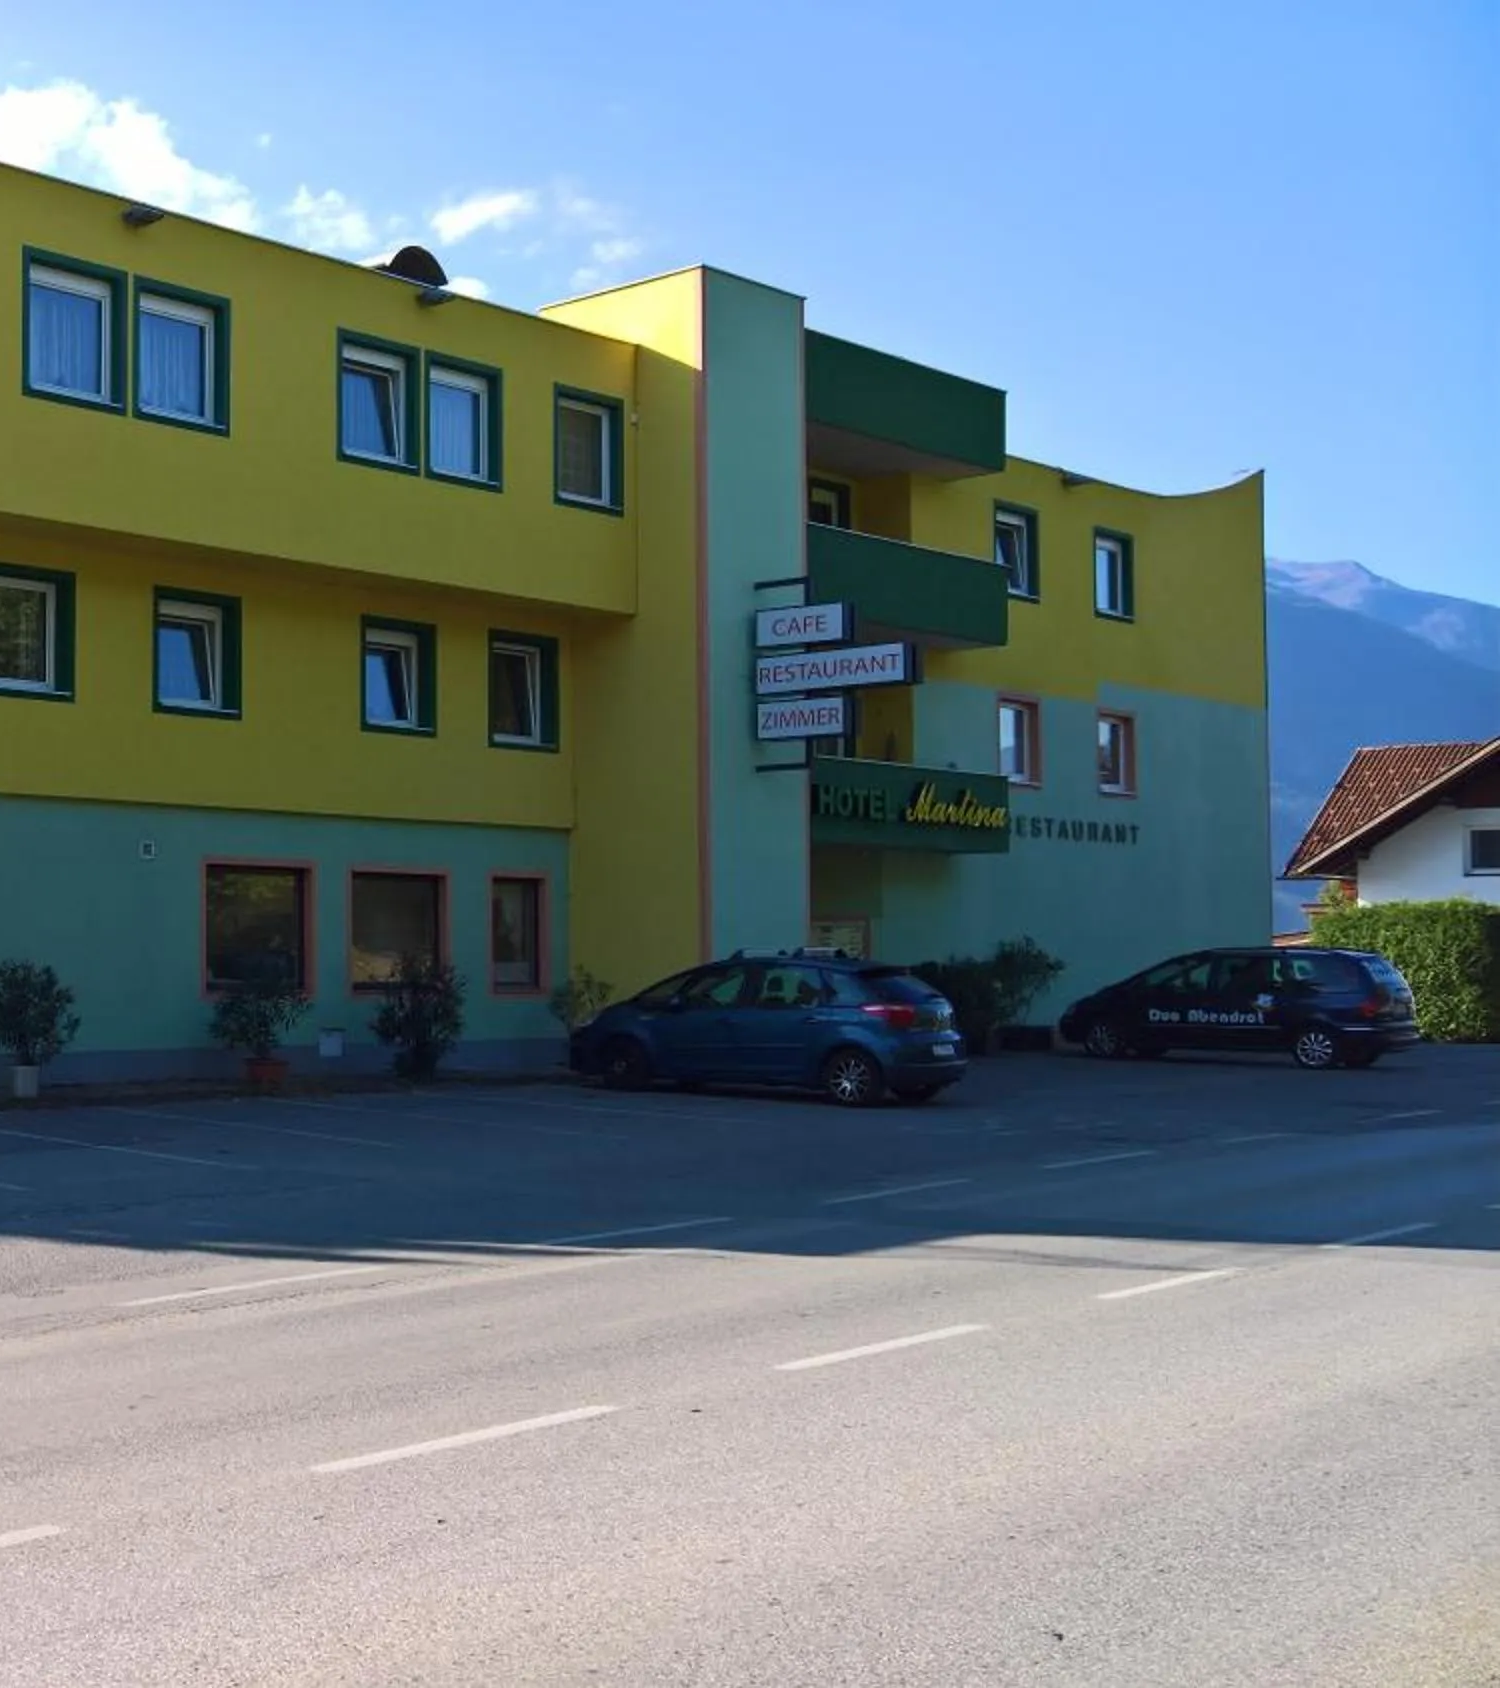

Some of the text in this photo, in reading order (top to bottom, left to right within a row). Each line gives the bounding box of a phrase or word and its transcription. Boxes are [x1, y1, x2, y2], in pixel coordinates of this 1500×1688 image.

[772, 614, 827, 637] CAFE
[759, 653, 900, 684] RESTAURANT
[761, 706, 840, 732] ZIMMER
[905, 781, 1006, 828] Martina
[1008, 811, 1141, 845] ESTAURANT
